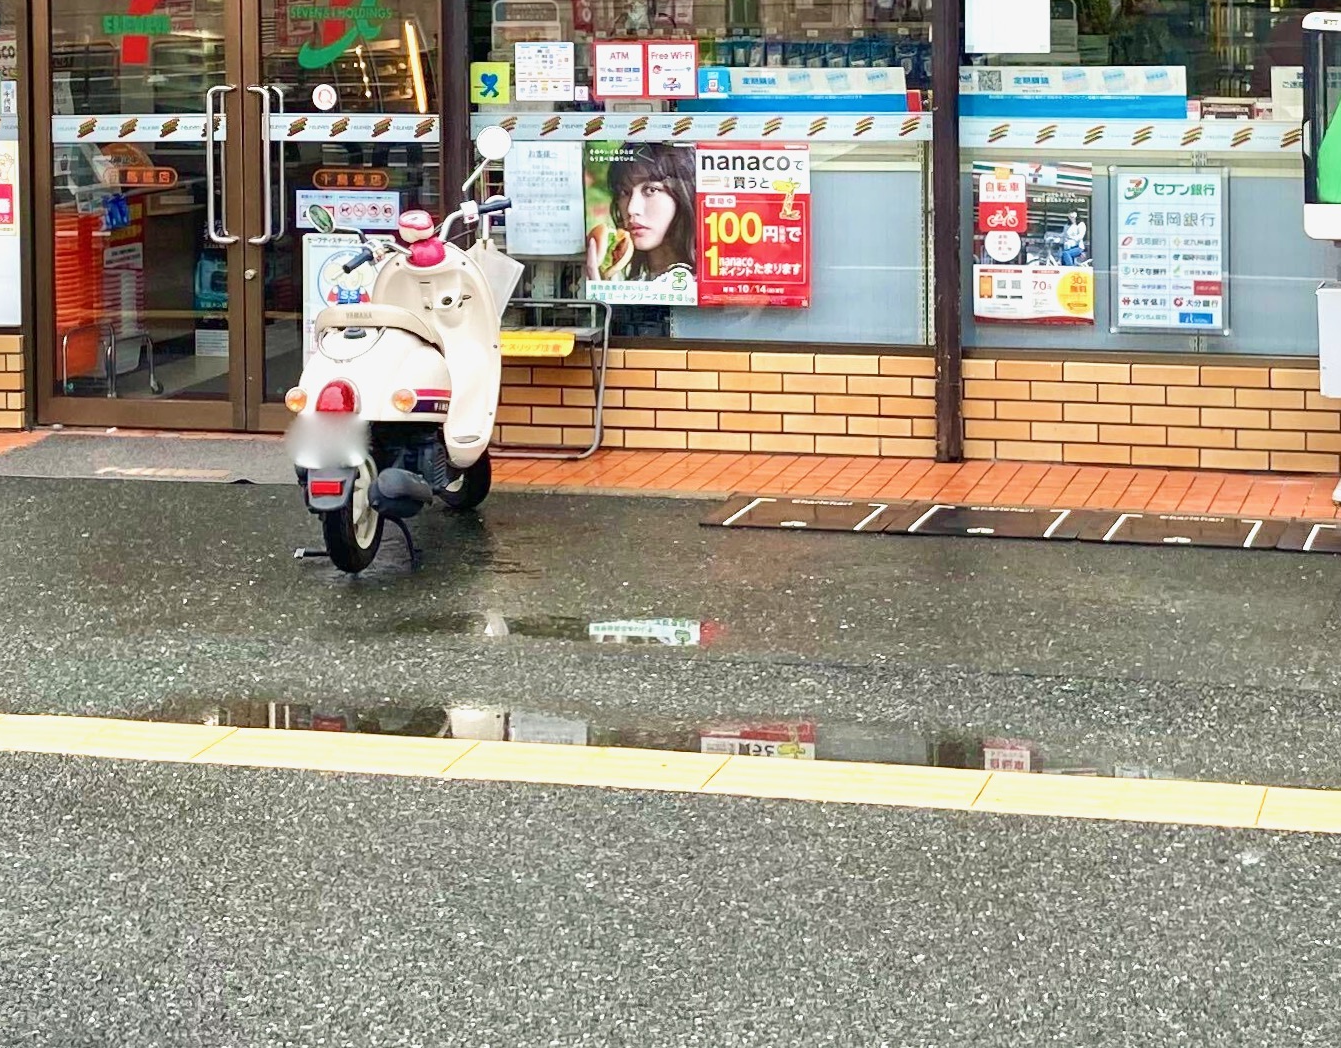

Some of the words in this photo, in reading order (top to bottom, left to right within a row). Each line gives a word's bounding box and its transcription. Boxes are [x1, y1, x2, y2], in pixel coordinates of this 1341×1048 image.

[610, 51, 629, 60] ATM
[651, 51, 668, 60] Free
[733, 177, 770, 189] 買うと
[985, 182, 1019, 192] 自転車
[1153, 182, 1216, 196] セブン銀行
[1148, 212, 1216, 227] 福岡銀行
[340, 290, 358, 299] SS
[1186, 298, 1218, 307] 大分銀行
